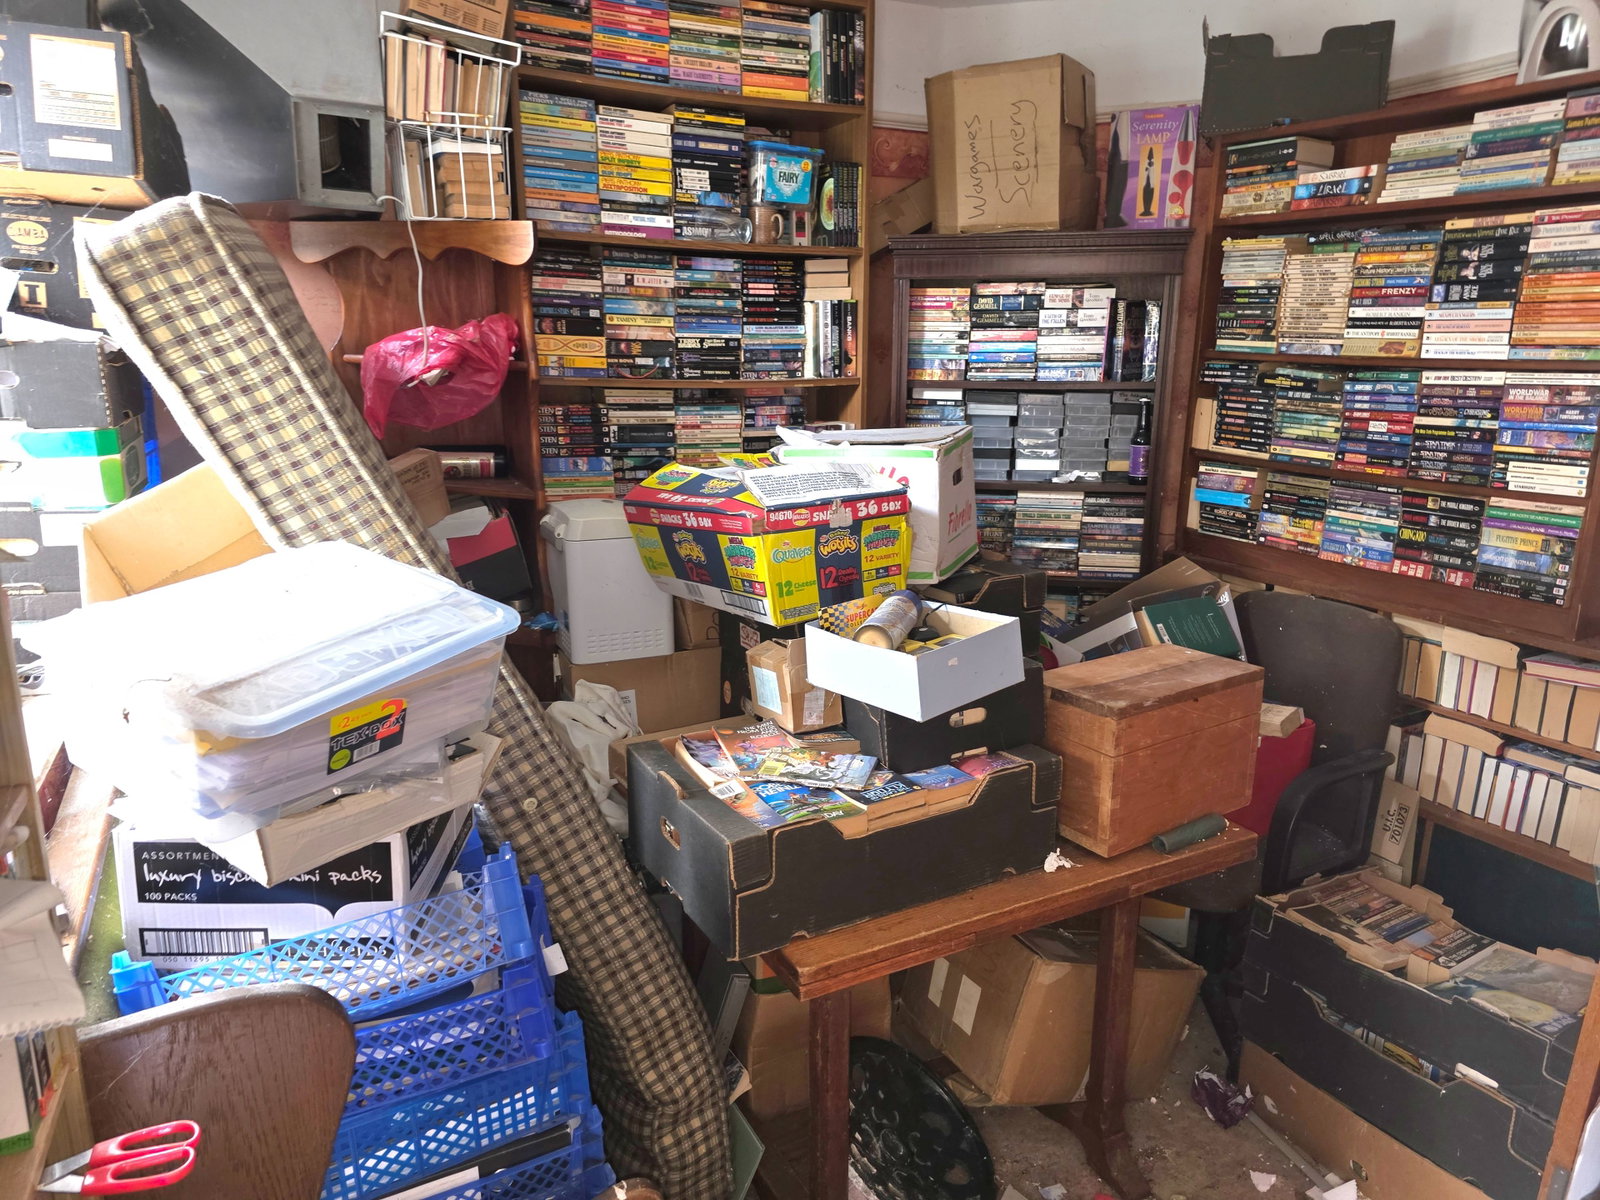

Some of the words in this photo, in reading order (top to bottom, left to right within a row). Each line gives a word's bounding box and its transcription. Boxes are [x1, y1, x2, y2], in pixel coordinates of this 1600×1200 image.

[1131, 119, 1179, 132] Serenity
[1135, 132, 1172, 145] LAMP
[999, 100, 1038, 208] Scenery
[964, 114, 991, 219] Wargames
[778, 171, 800, 184] FAIRY
[1381, 287, 1417, 295] FRENZY
[769, 510, 792, 522] 94670
[856, 500, 879, 517] 36
[881, 501, 902, 513] BOX
[1459, 503, 1474, 511] KINGDOM
[682, 511, 698, 528] 36
[1496, 535, 1518, 546] FUGITIVE
[1520, 538, 1539, 548] PRINCE
[864, 554, 875, 562] 12
[876, 552, 900, 561] VARIETY
[730, 567, 740, 577] 12
[740, 572, 759, 581] VARIETY
[820, 566, 839, 589] 12
[776, 580, 794, 598] 12
[1383, 808, 1397, 833] U.I.C.
[1389, 806, 1409, 844] 701073
[141, 850, 224, 861] ASSORTMEN
[143, 863, 203, 890] luxury
[328, 863, 382, 885] packs
[143, 891, 161, 902] 100
[164, 891, 198, 902] PACKS
